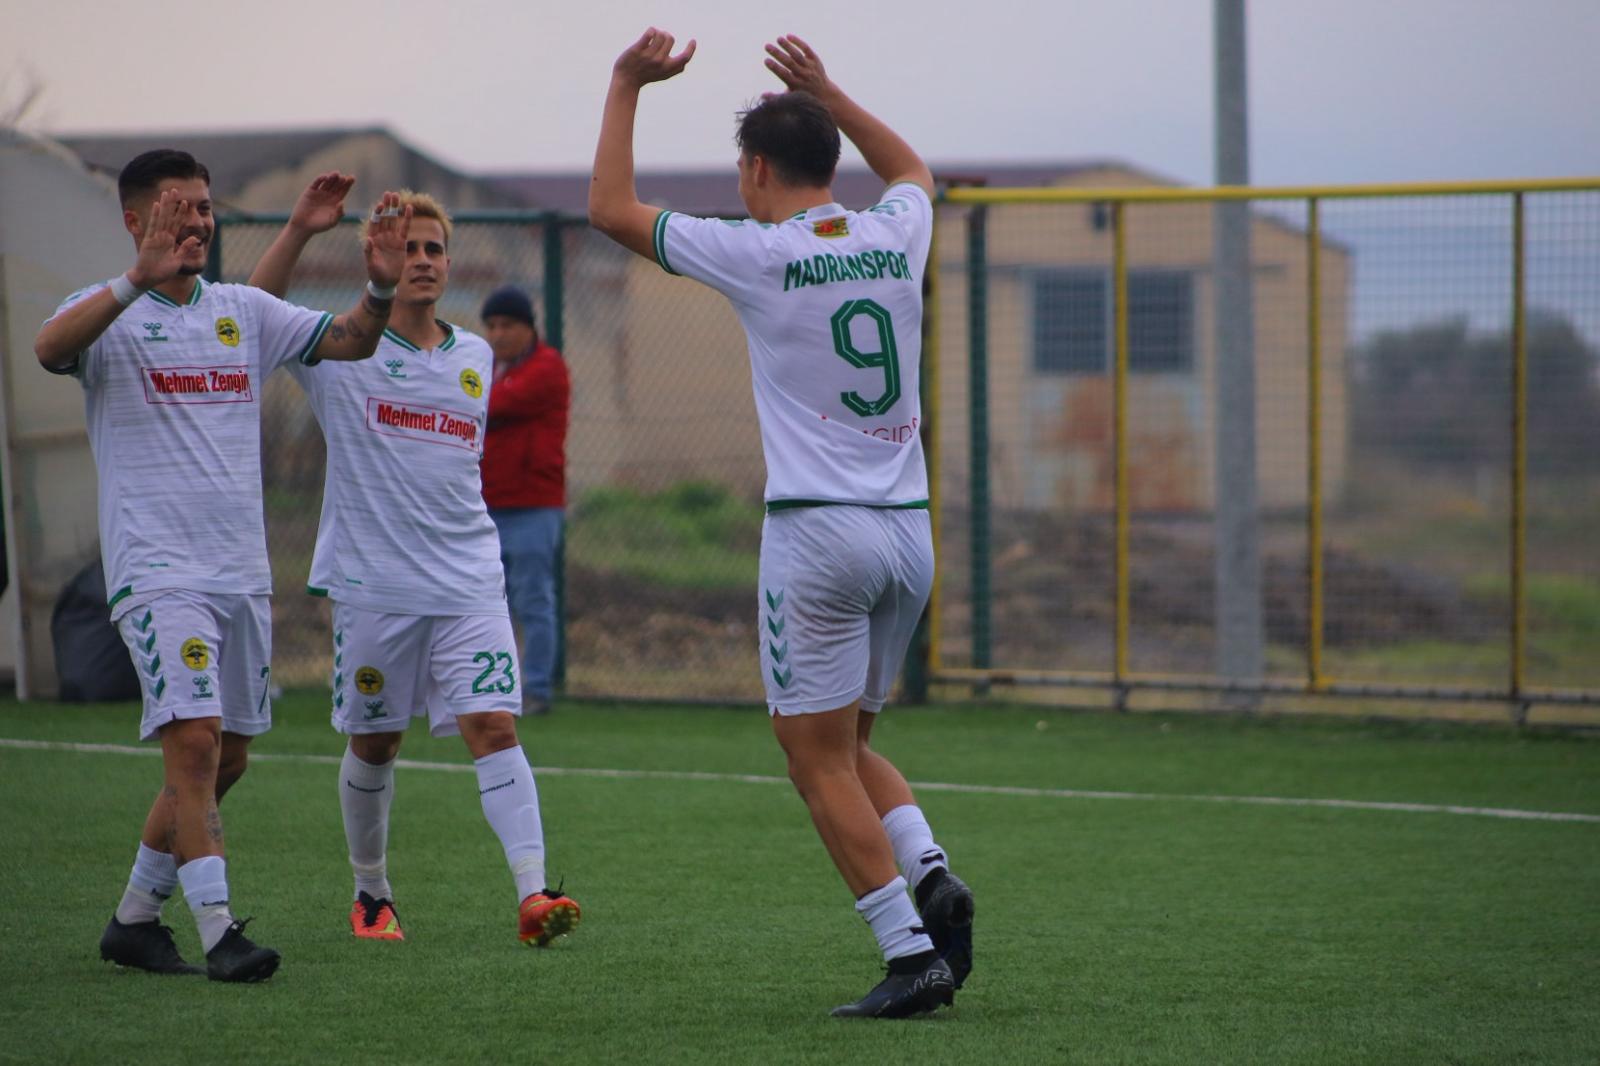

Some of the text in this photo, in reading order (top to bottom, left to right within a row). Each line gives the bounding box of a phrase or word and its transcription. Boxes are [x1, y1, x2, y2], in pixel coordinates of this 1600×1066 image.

[783, 250, 913, 291] MADRANSPOR
[830, 297, 901, 418] 9
[149, 371, 209, 394] Mehmet
[377, 403, 436, 433] Mehmet
[472, 651, 515, 694] 23
